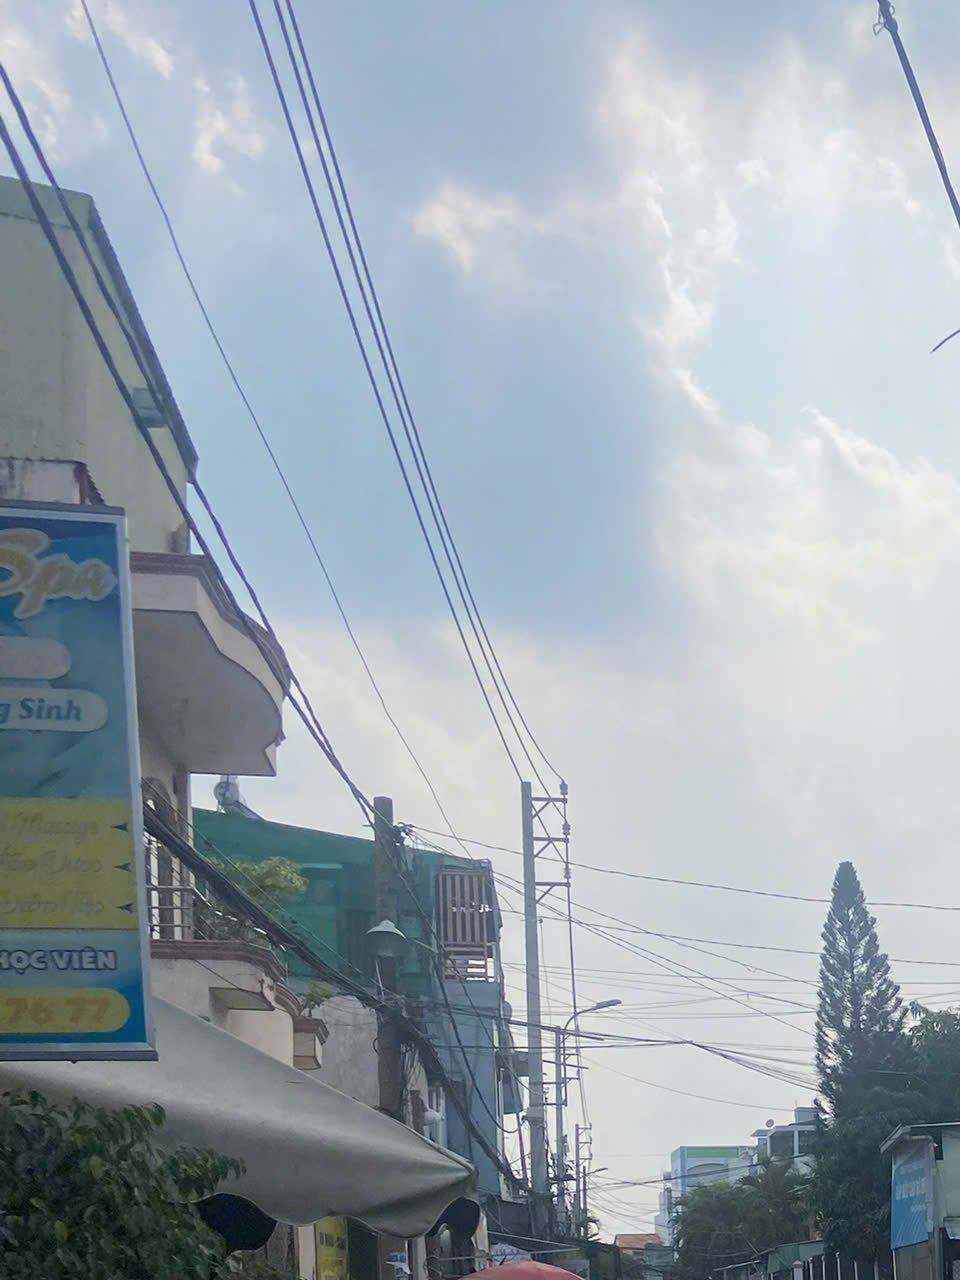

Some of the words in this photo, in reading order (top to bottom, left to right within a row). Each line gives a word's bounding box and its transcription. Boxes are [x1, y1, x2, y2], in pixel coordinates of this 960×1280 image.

[0, 528, 117, 619] Spa
[19, 698, 82, 720] Sinh
[51, 946, 117, 970] VIÊN
